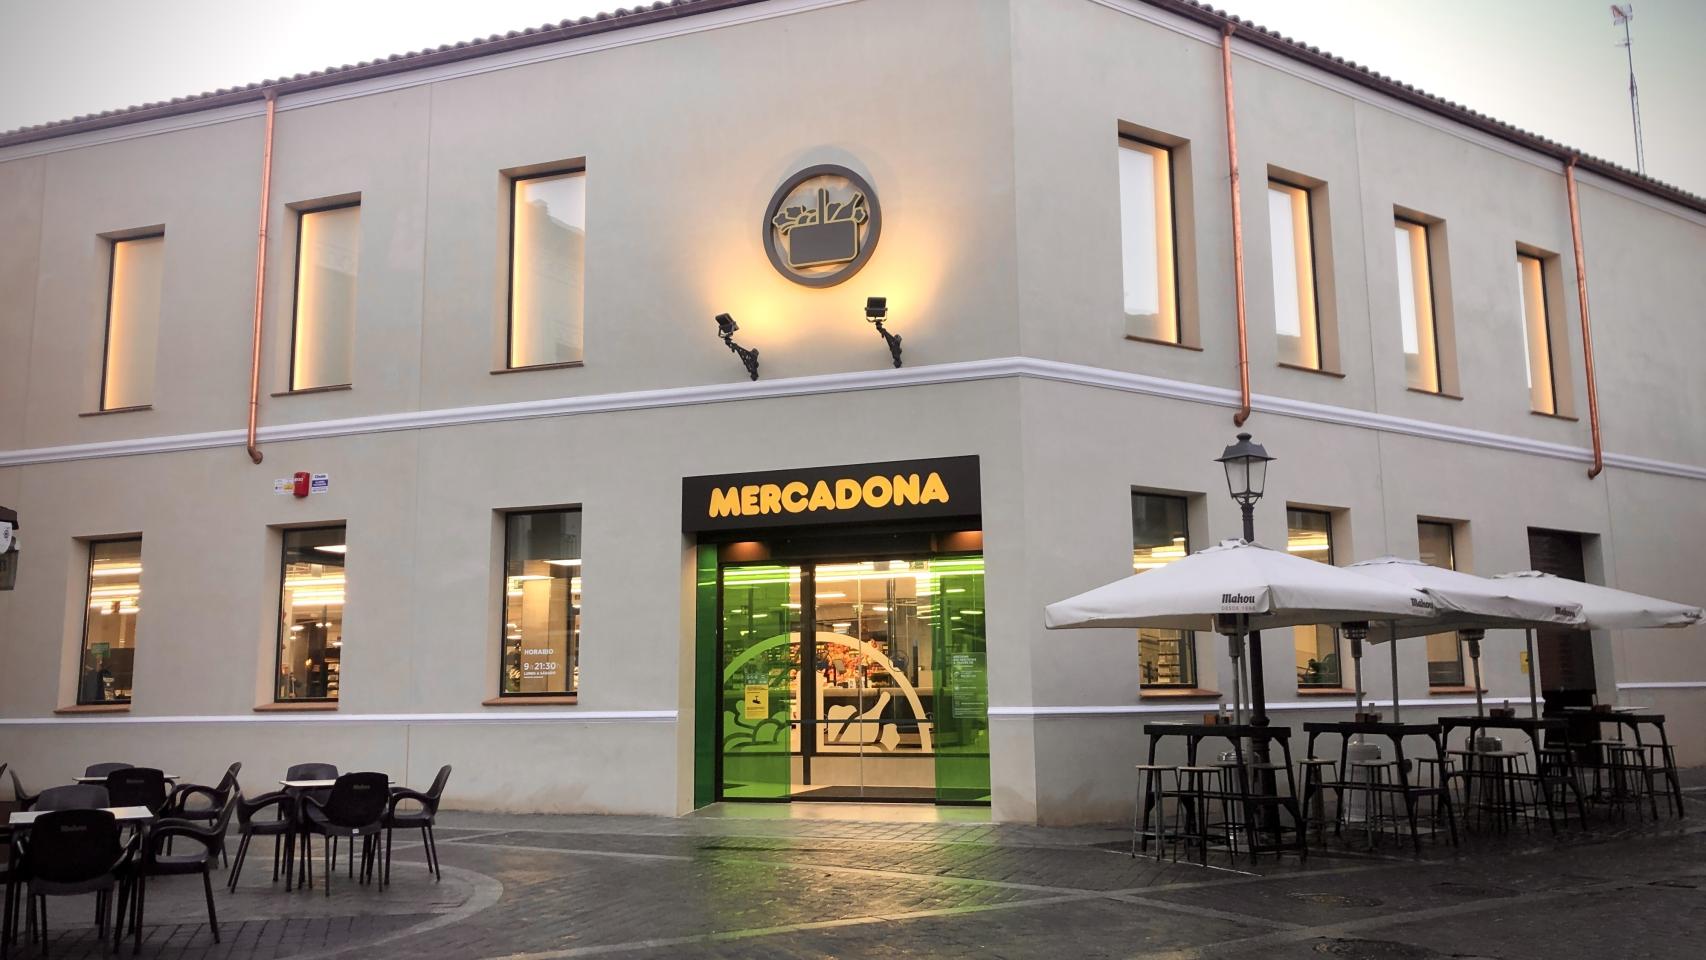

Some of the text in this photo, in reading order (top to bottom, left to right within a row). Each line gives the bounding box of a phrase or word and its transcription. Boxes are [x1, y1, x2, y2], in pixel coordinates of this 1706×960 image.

[708, 472, 949, 518] MERCADONA
[1221, 593, 1255, 604] Mahou
[534, 662, 556, 670] 21:30
